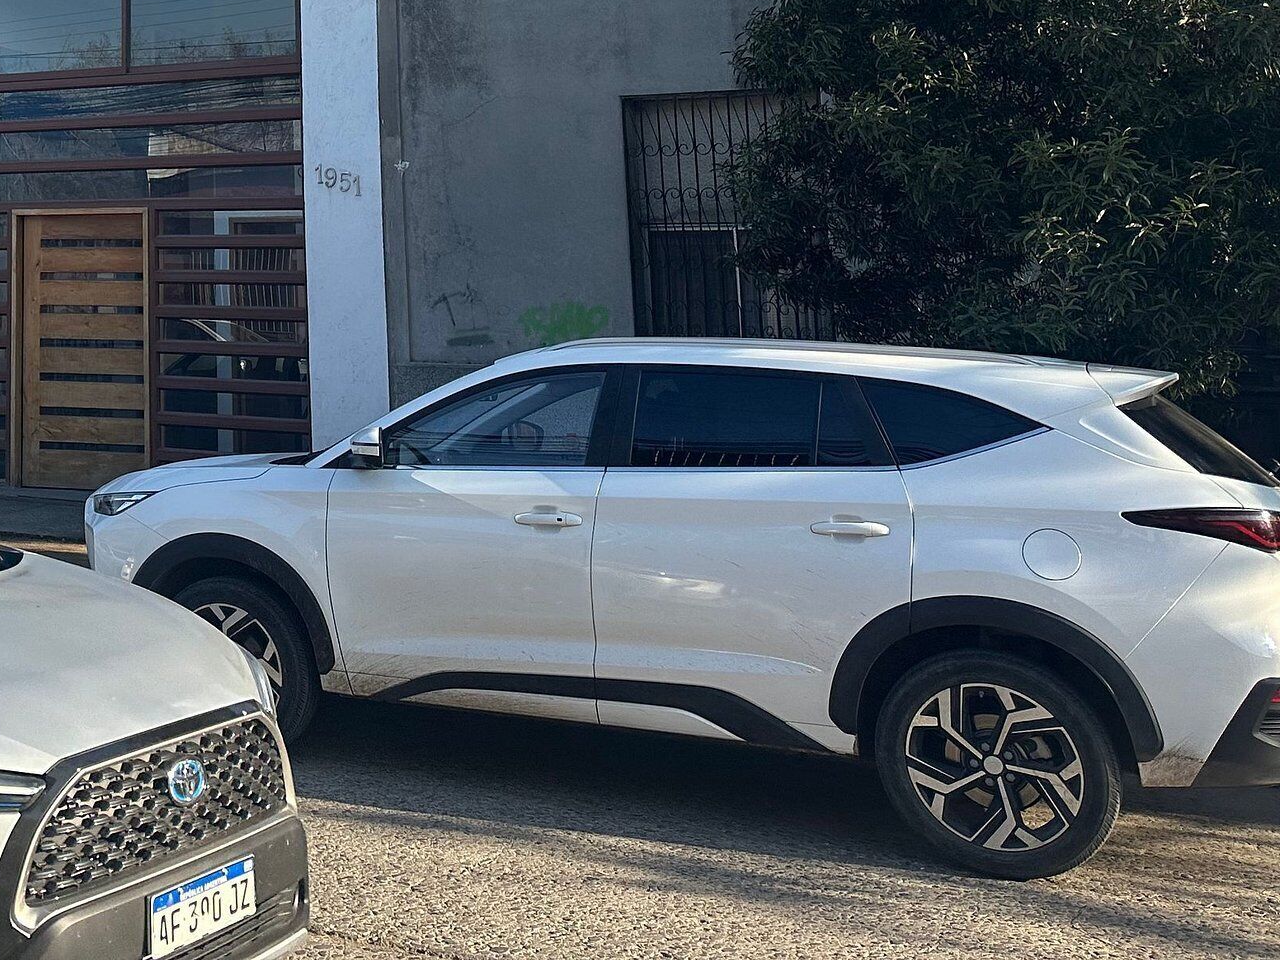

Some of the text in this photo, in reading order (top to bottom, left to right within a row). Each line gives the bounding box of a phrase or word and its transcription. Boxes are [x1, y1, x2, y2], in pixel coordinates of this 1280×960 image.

[315, 163, 361, 197] 1951
[160, 908, 180, 945] AF
[229, 879, 250, 915] JZ
